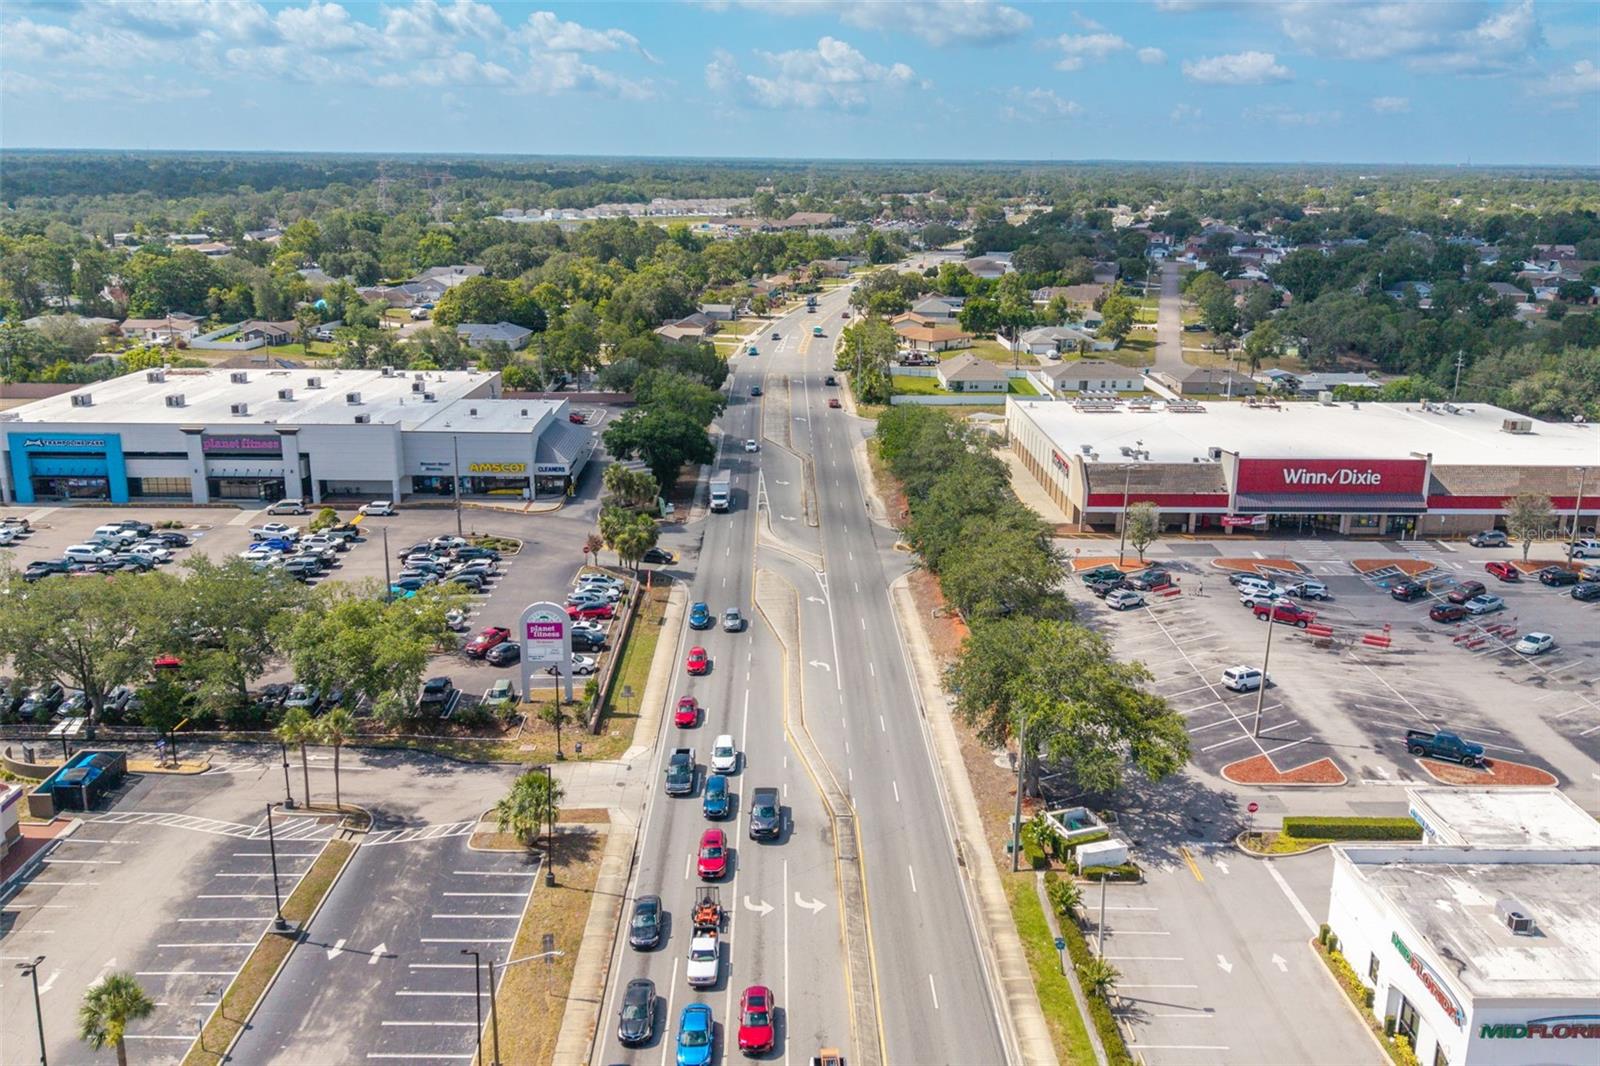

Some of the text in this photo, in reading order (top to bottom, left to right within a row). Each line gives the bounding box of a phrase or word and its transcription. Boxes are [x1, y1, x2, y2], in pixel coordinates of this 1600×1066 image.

[203, 438, 279, 450] planet fitness
[469, 463, 527, 473] AMSCOT
[1283, 468, 1381, 484] Winn Dixie
[530, 625, 555, 634] planet
